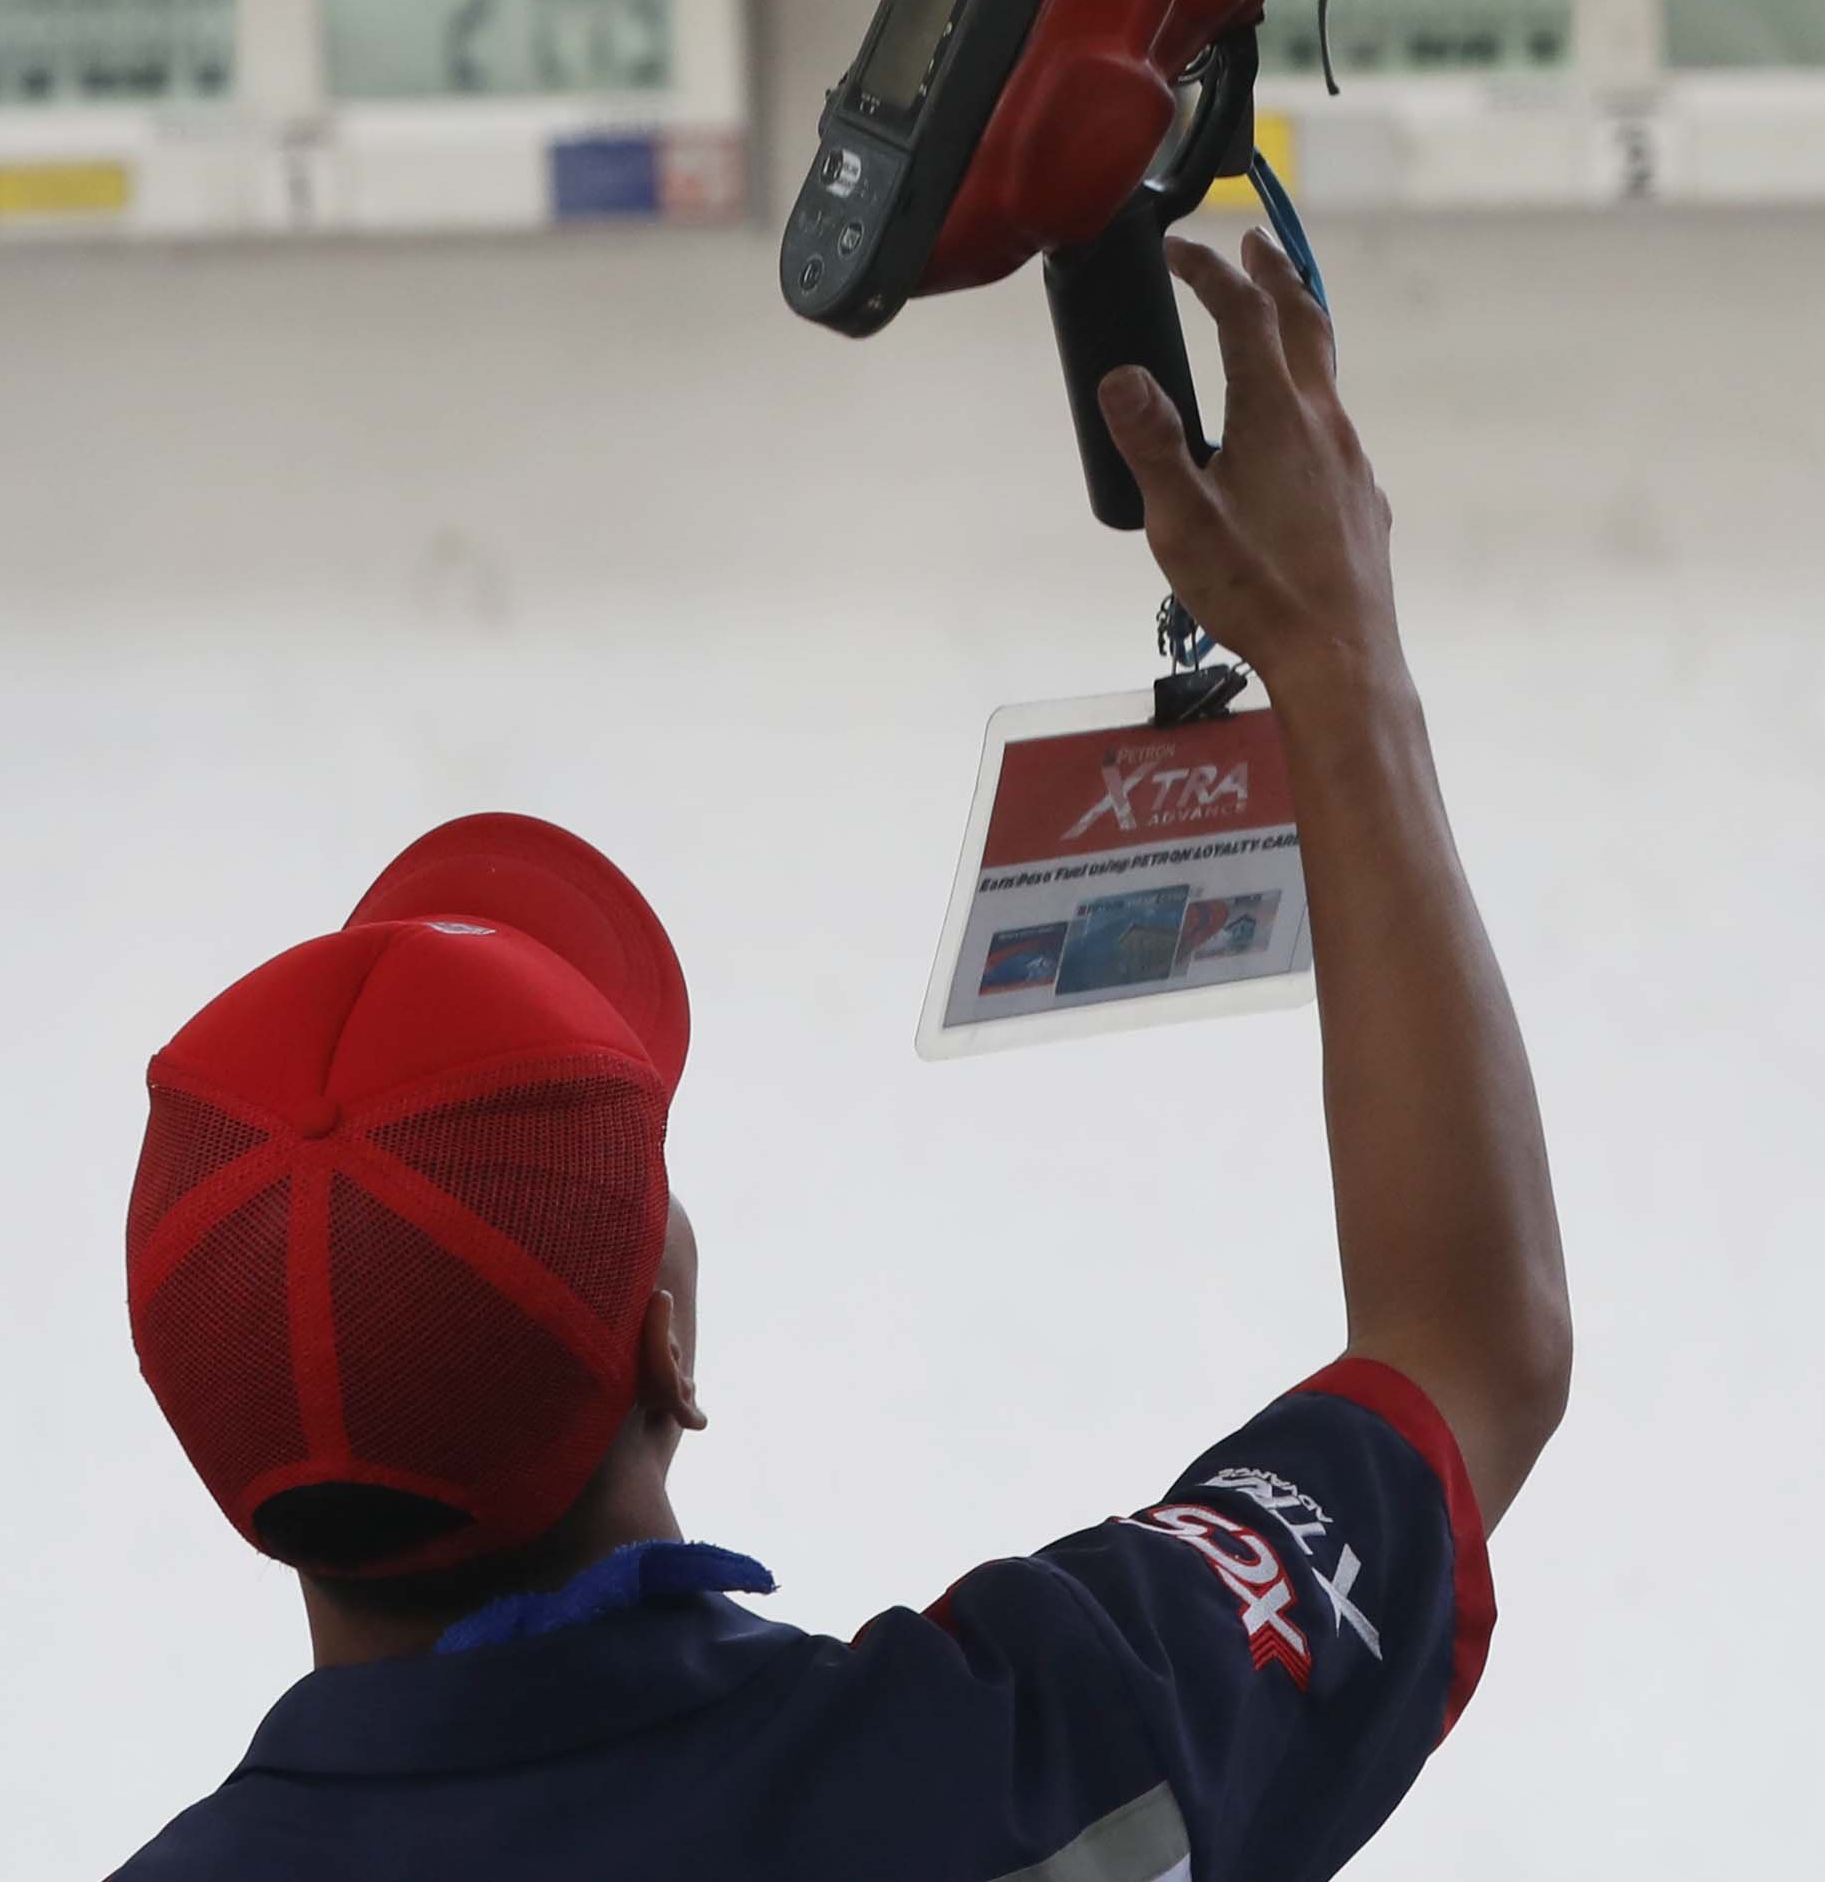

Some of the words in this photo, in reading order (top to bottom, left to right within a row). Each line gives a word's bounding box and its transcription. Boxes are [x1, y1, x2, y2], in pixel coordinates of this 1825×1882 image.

[1058, 760, 1249, 841] XTRA
[1147, 800, 1247, 827] ADVANCE
[1131, 848, 1192, 869] PETRON
[1192, 837, 1261, 860] LOYALTY
